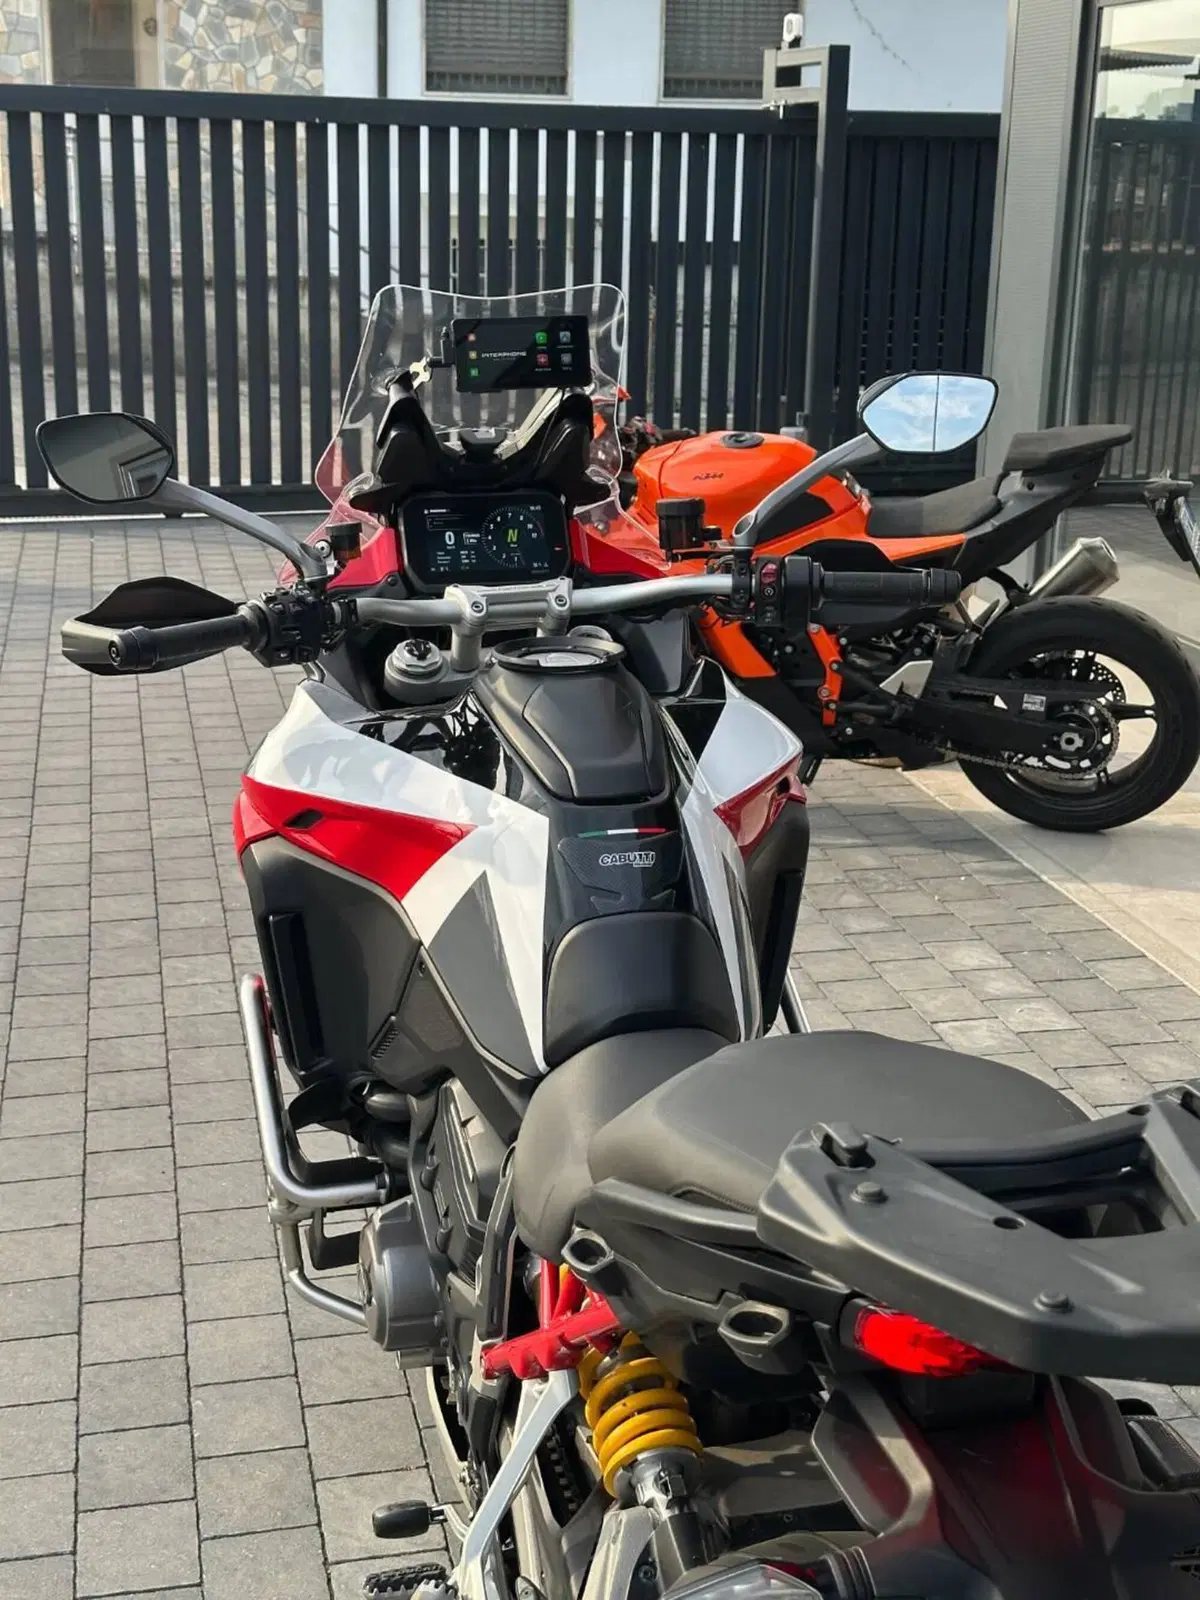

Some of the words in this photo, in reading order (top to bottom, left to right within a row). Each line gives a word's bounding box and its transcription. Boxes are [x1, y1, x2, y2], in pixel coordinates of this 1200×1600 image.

[444, 531, 455, 545] 0
[507, 528, 519, 542] N
[599, 851, 656, 866] CABUTTI
